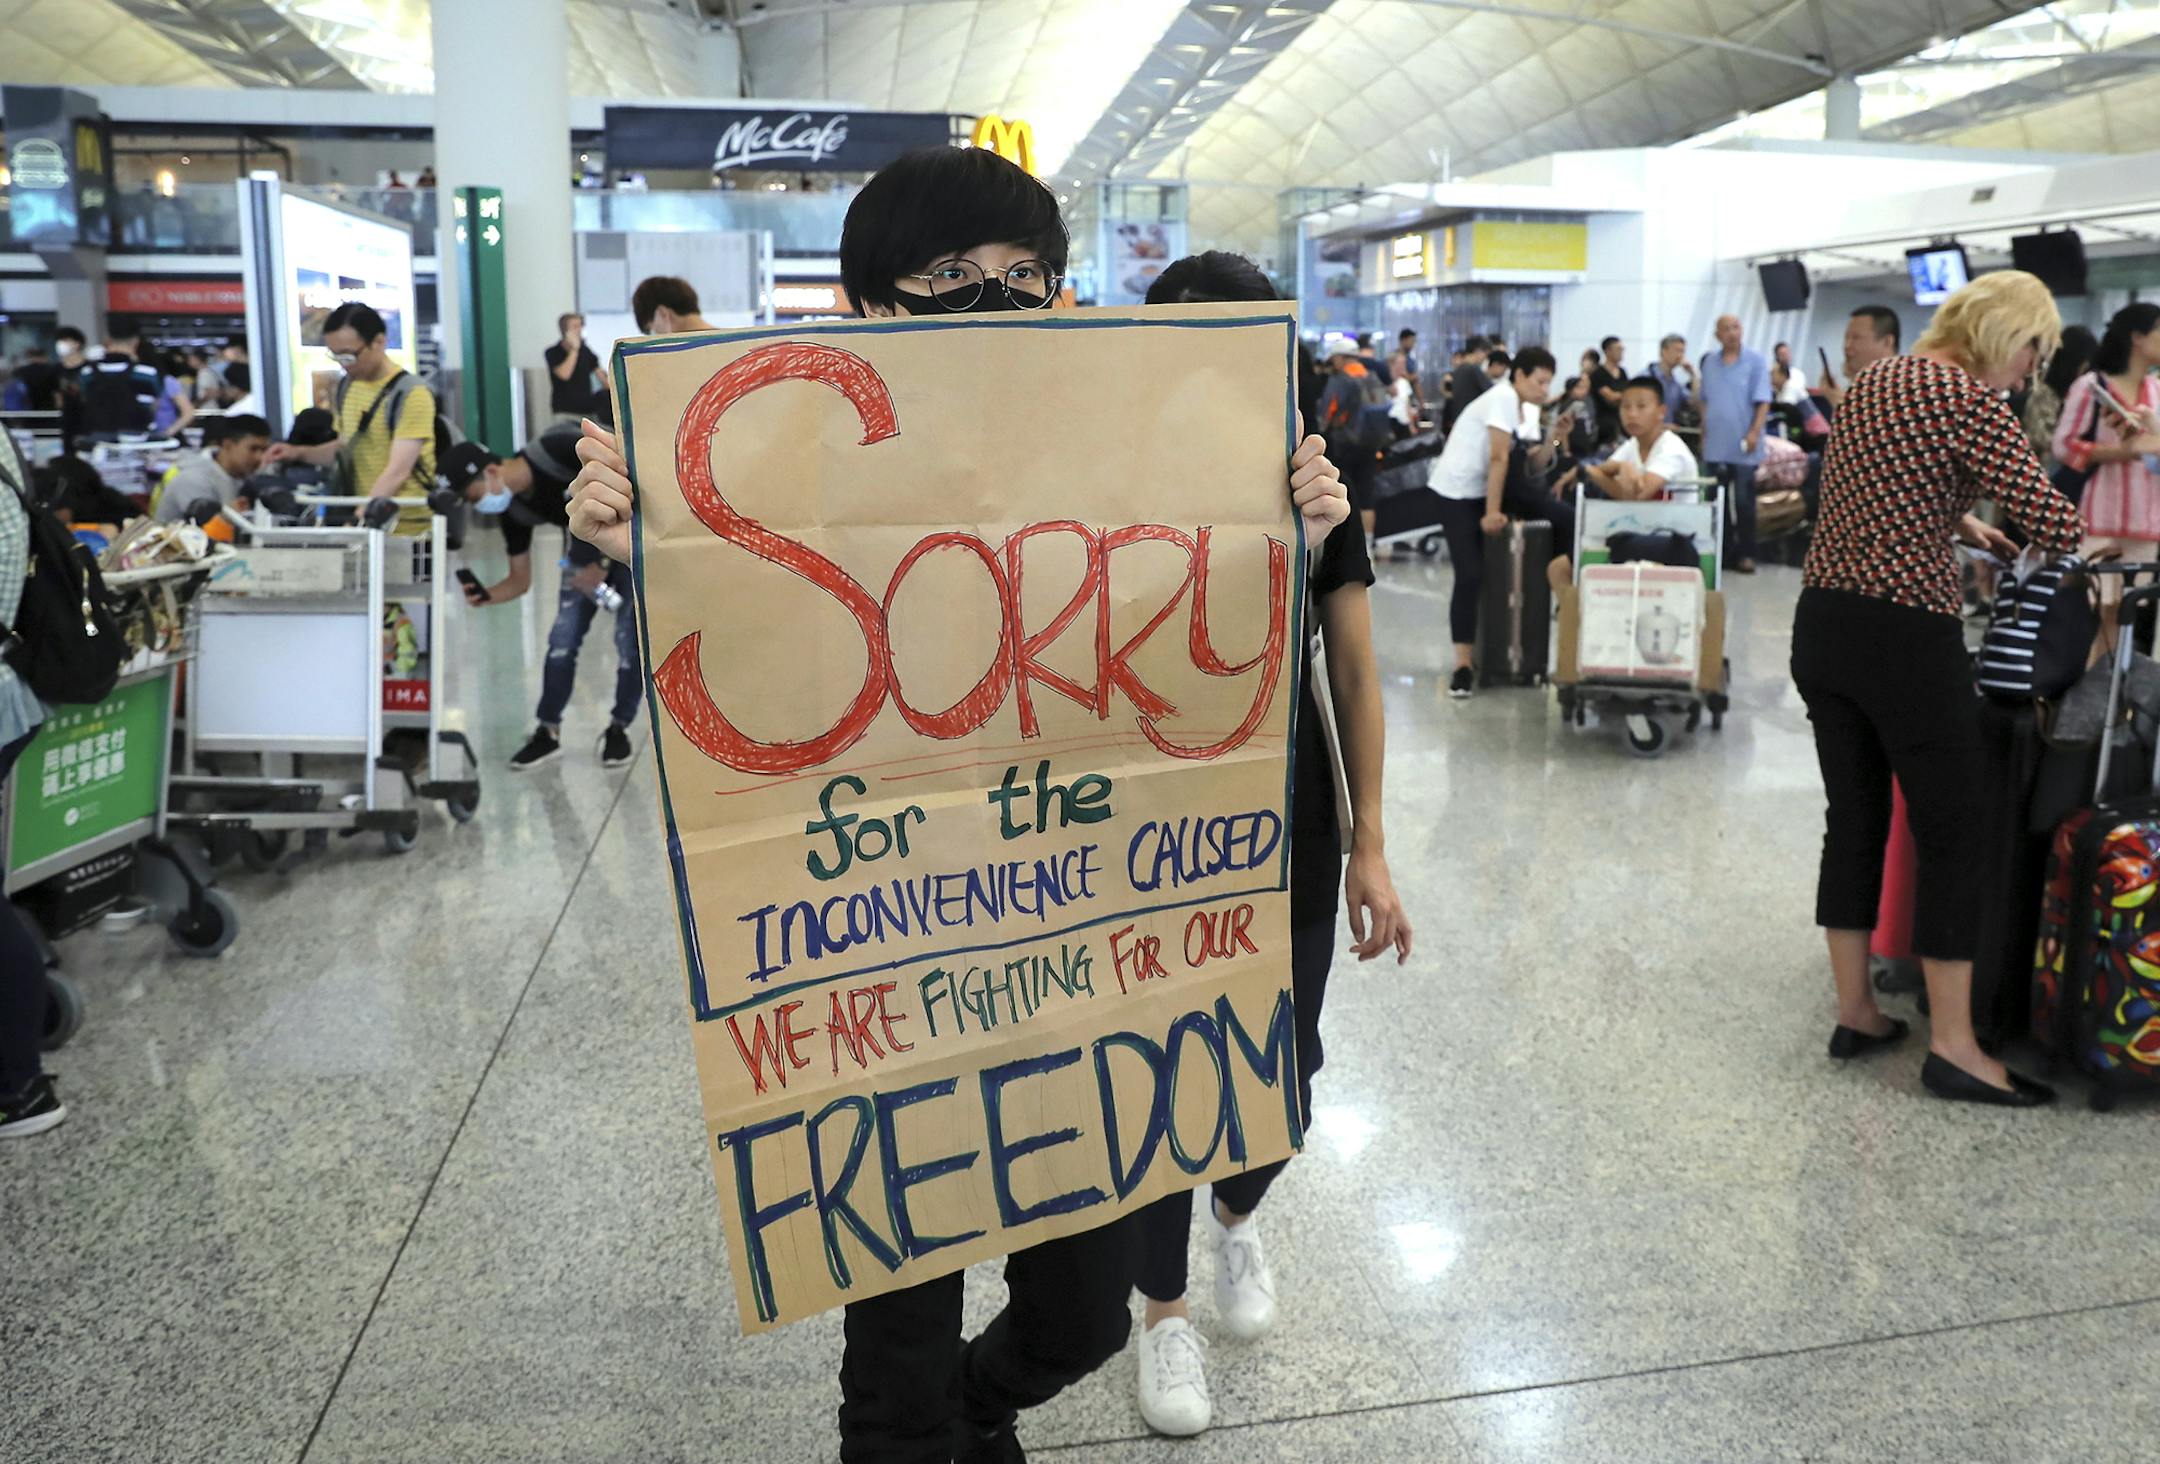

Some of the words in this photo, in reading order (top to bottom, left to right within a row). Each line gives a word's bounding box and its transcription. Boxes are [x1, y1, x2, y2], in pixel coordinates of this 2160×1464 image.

[714, 112, 849, 167] McCafé
[737, 843, 1103, 984] INCONVENIENCE
[1126, 808, 1283, 892] CAUSED
[804, 775, 927, 881] for
[987, 760, 1112, 842] the
[725, 1001, 817, 1096] WE
[825, 981, 914, 1076] ARE
[917, 943, 1096, 1038] FIGHTING
[1183, 902, 1260, 969] OUR
[718, 987, 1305, 1324] FREEDOM
